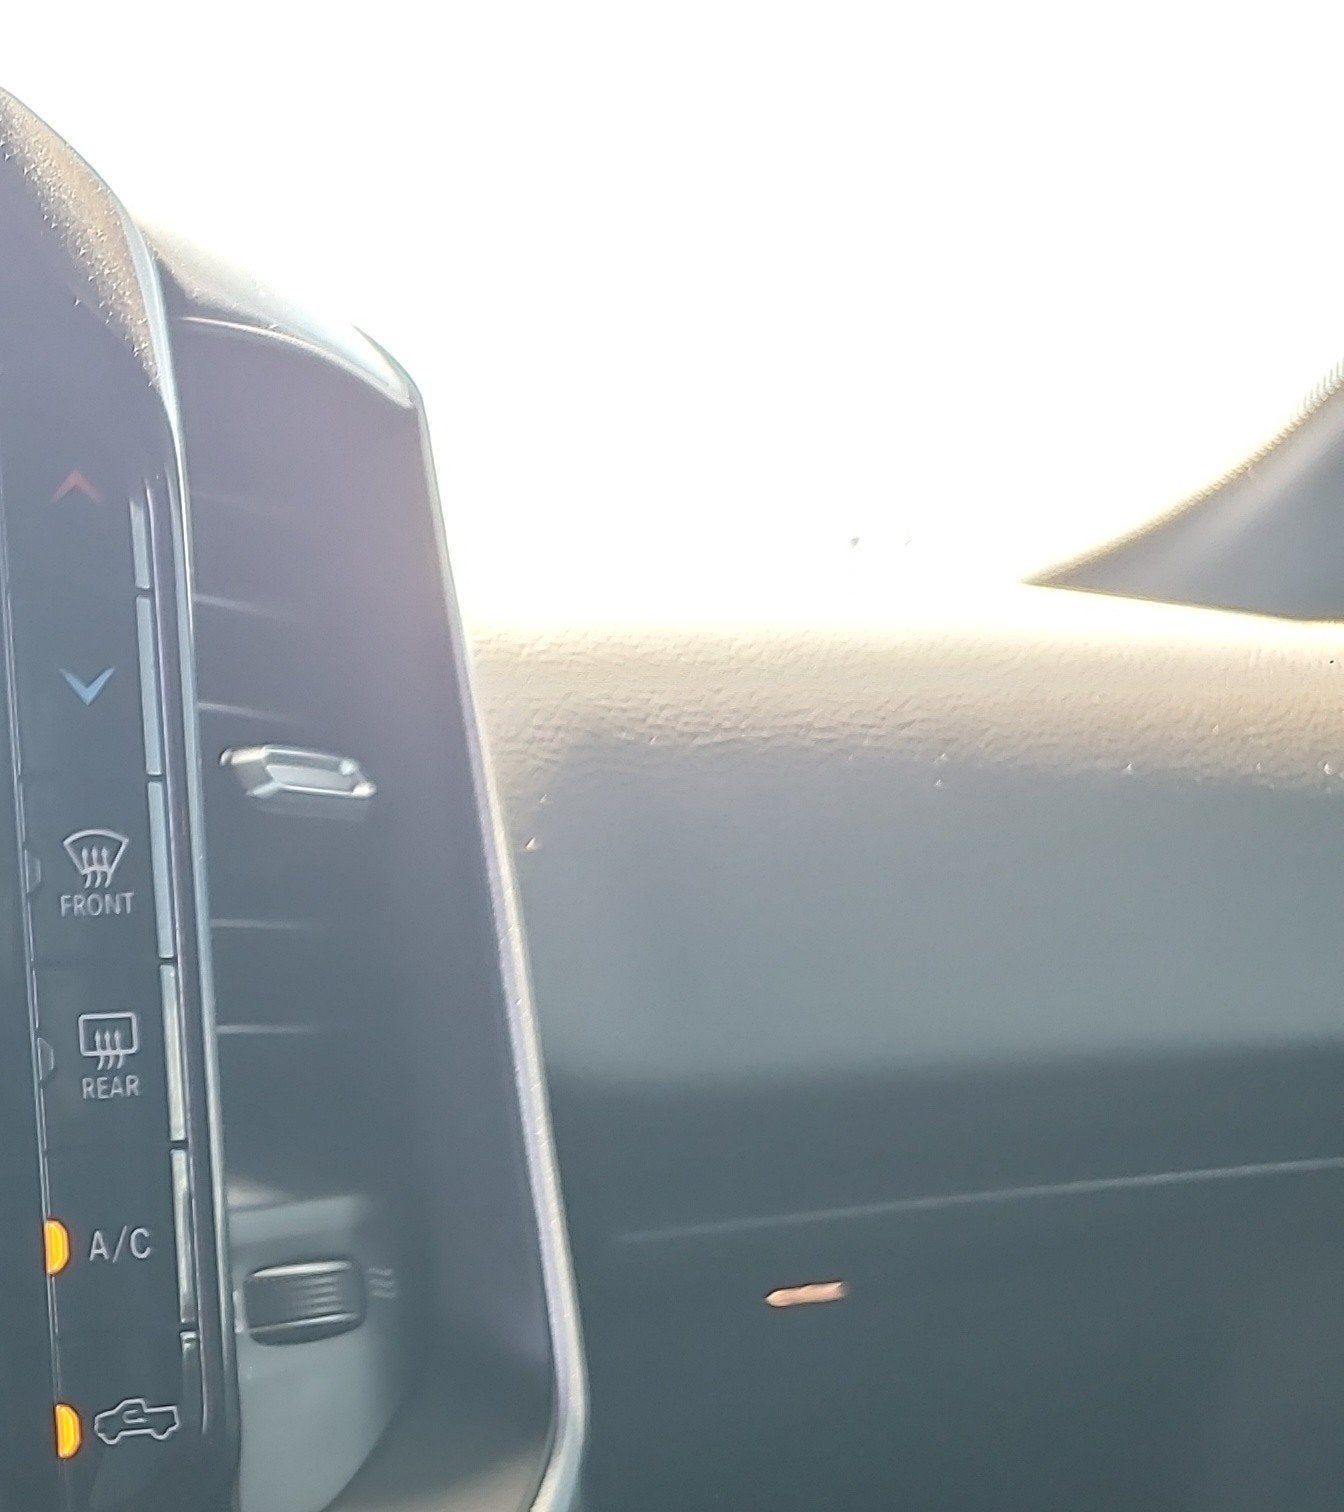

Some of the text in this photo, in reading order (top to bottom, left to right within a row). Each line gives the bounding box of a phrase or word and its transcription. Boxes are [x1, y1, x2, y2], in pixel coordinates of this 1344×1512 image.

[61, 893, 135, 917] FRONT
[81, 1075, 140, 1100] REAR
[88, 1225, 152, 1264] A/C
